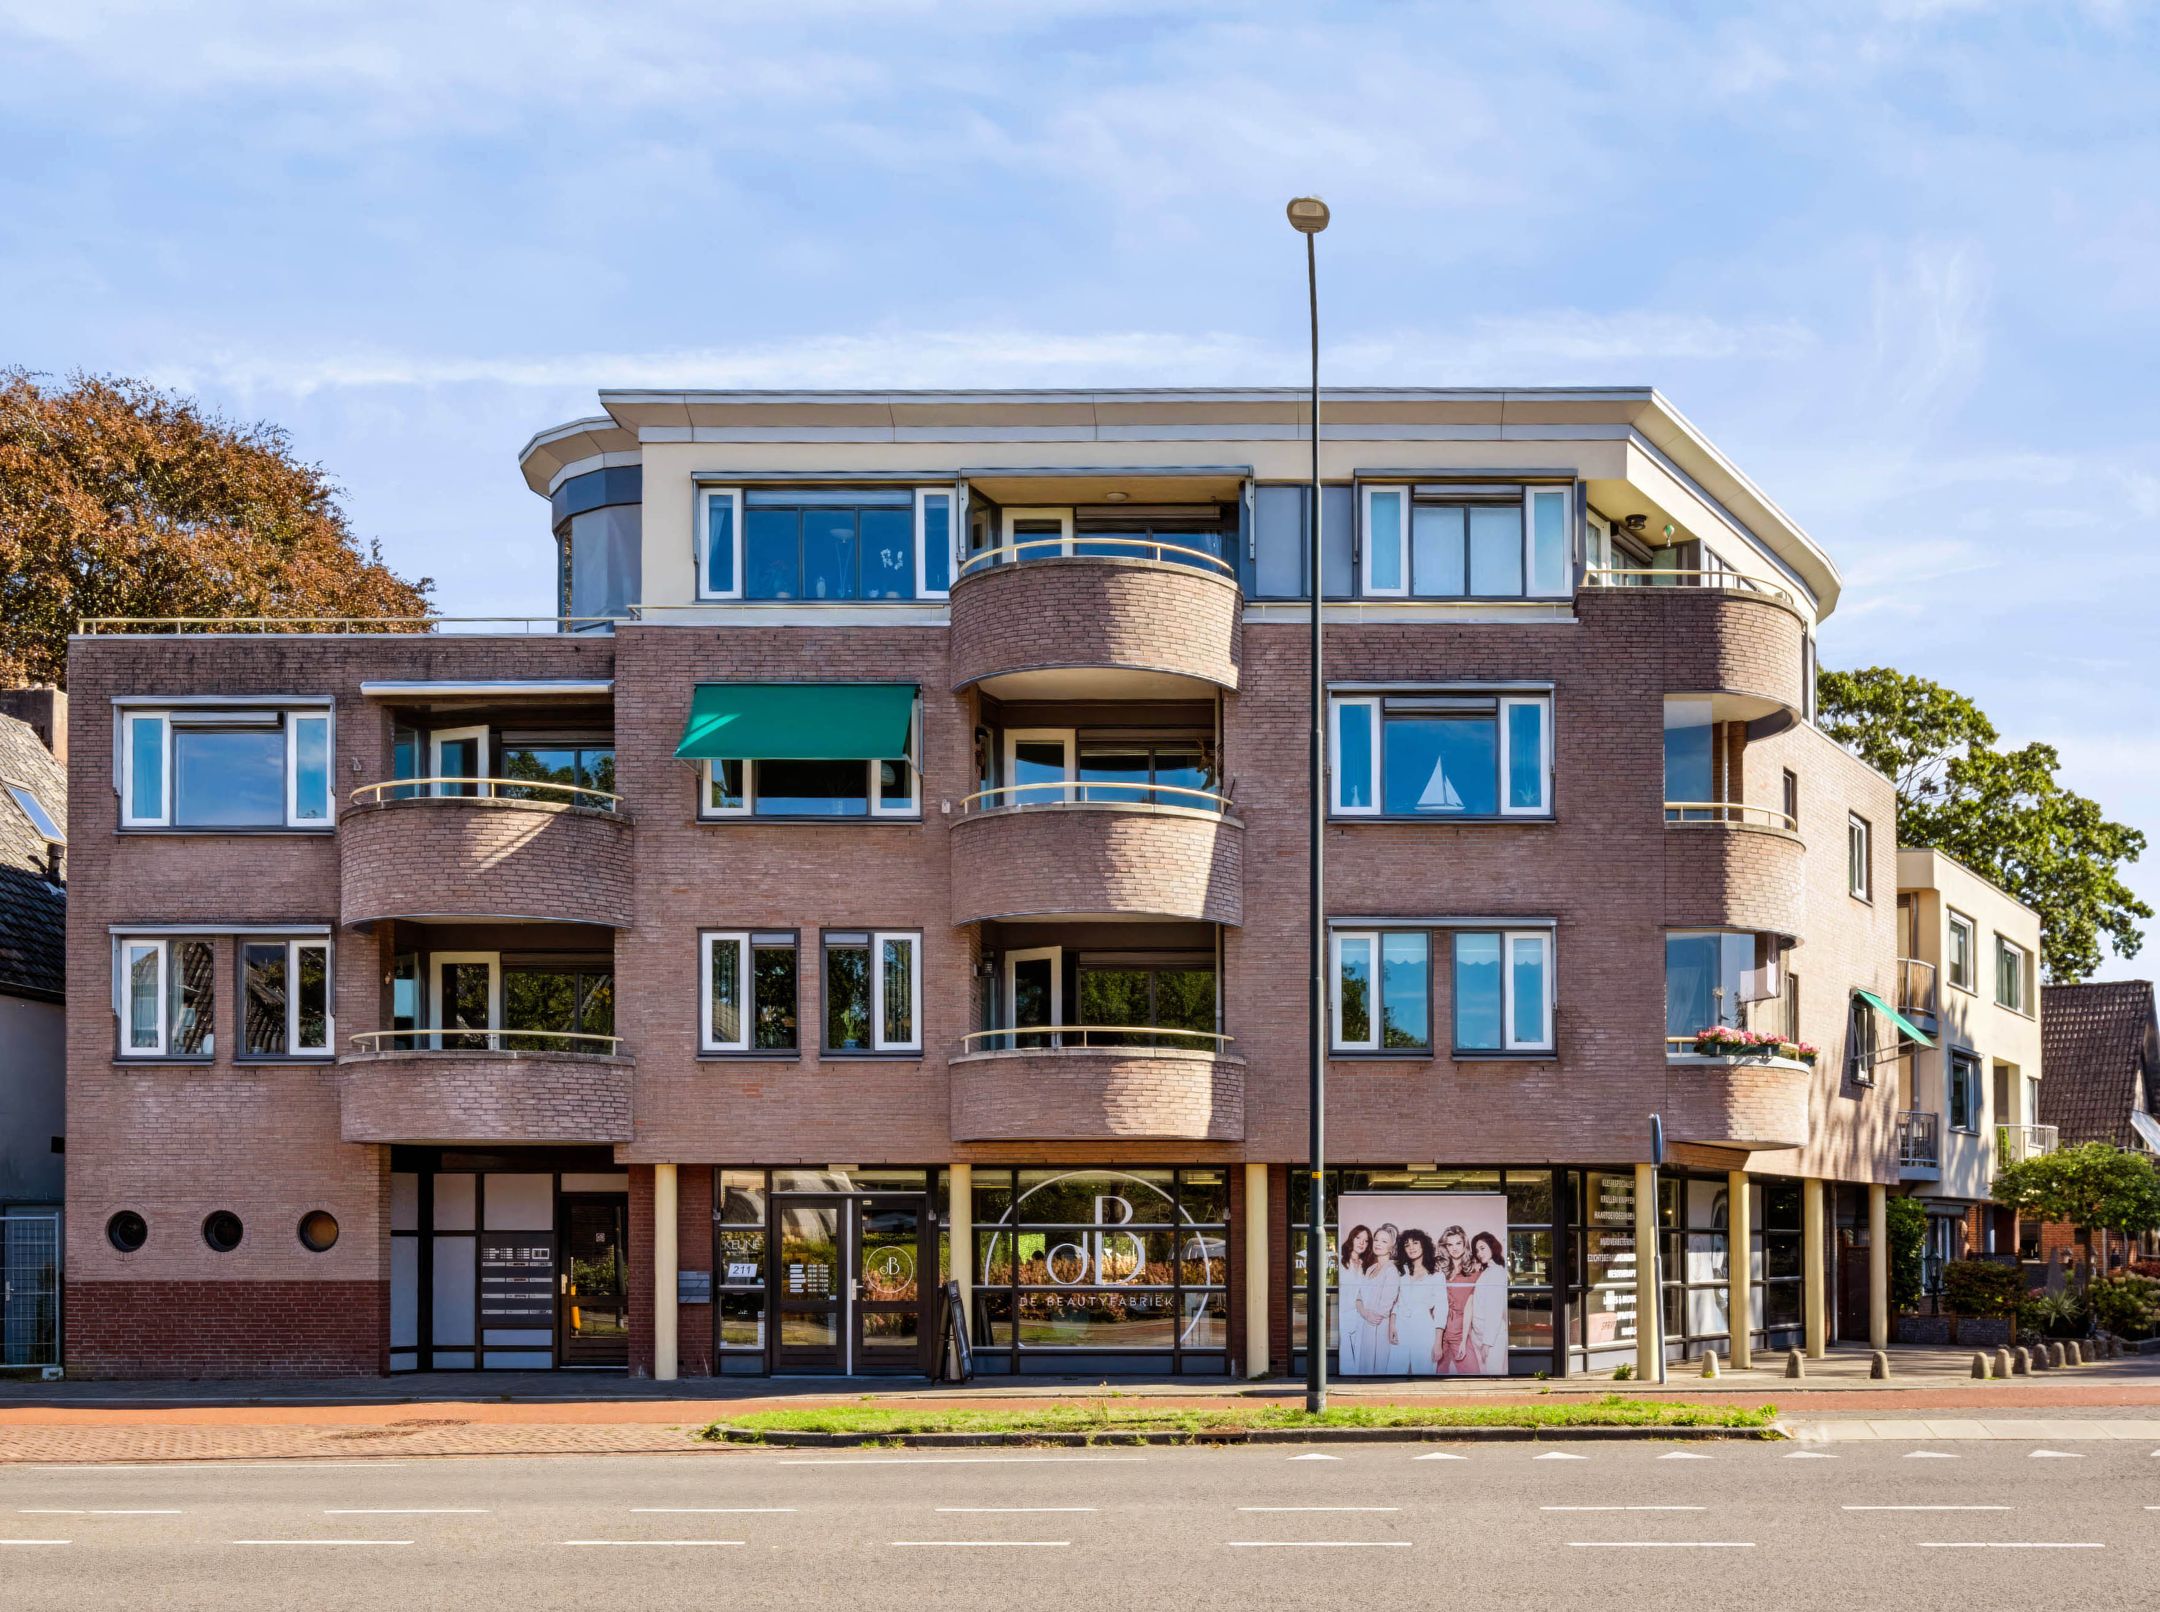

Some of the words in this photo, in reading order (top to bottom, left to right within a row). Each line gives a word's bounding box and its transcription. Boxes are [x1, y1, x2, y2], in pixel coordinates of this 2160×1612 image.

[732, 1265, 752, 1275] 211
[1019, 1297, 1037, 1307] DE
[1046, 1296, 1174, 1307] BEAUTYFABRIEK
